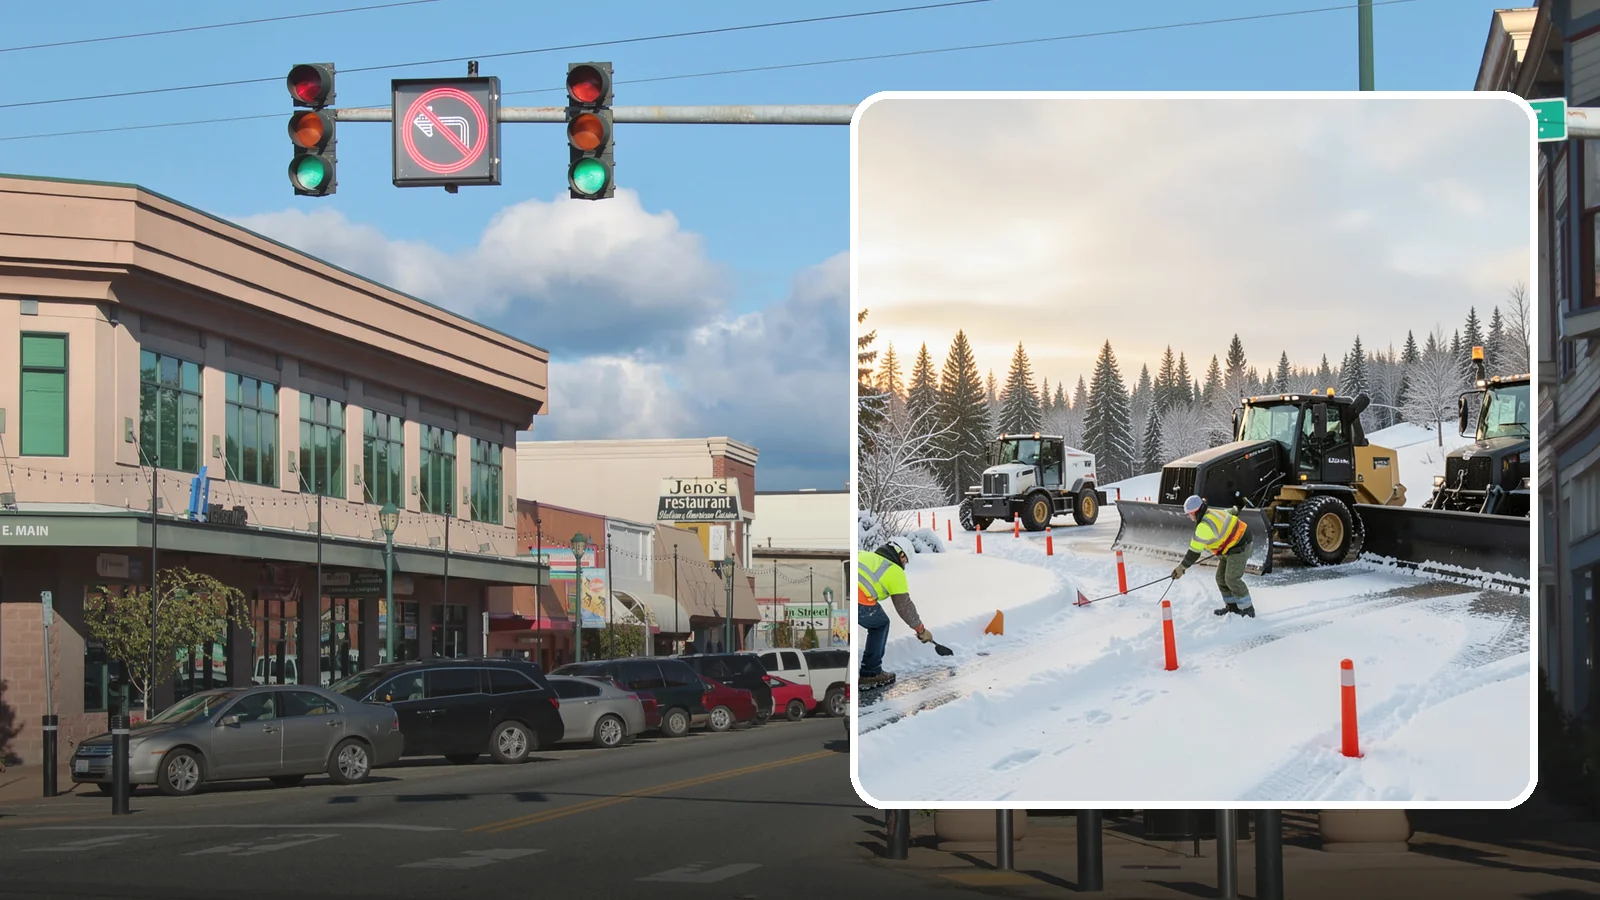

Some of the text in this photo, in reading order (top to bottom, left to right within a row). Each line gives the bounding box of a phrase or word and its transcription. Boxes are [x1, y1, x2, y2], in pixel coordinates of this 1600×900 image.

[669, 479, 728, 495] Jeno's
[664, 496, 731, 509] restaurant
[658, 509, 681, 520] Italian
[685, 509, 715, 520] American
[714, 509, 738, 520] Cuisine
[2, 525, 49, 536] E. MAIN
[797, 606, 829, 617] Street
[790, 619, 824, 627] lass
